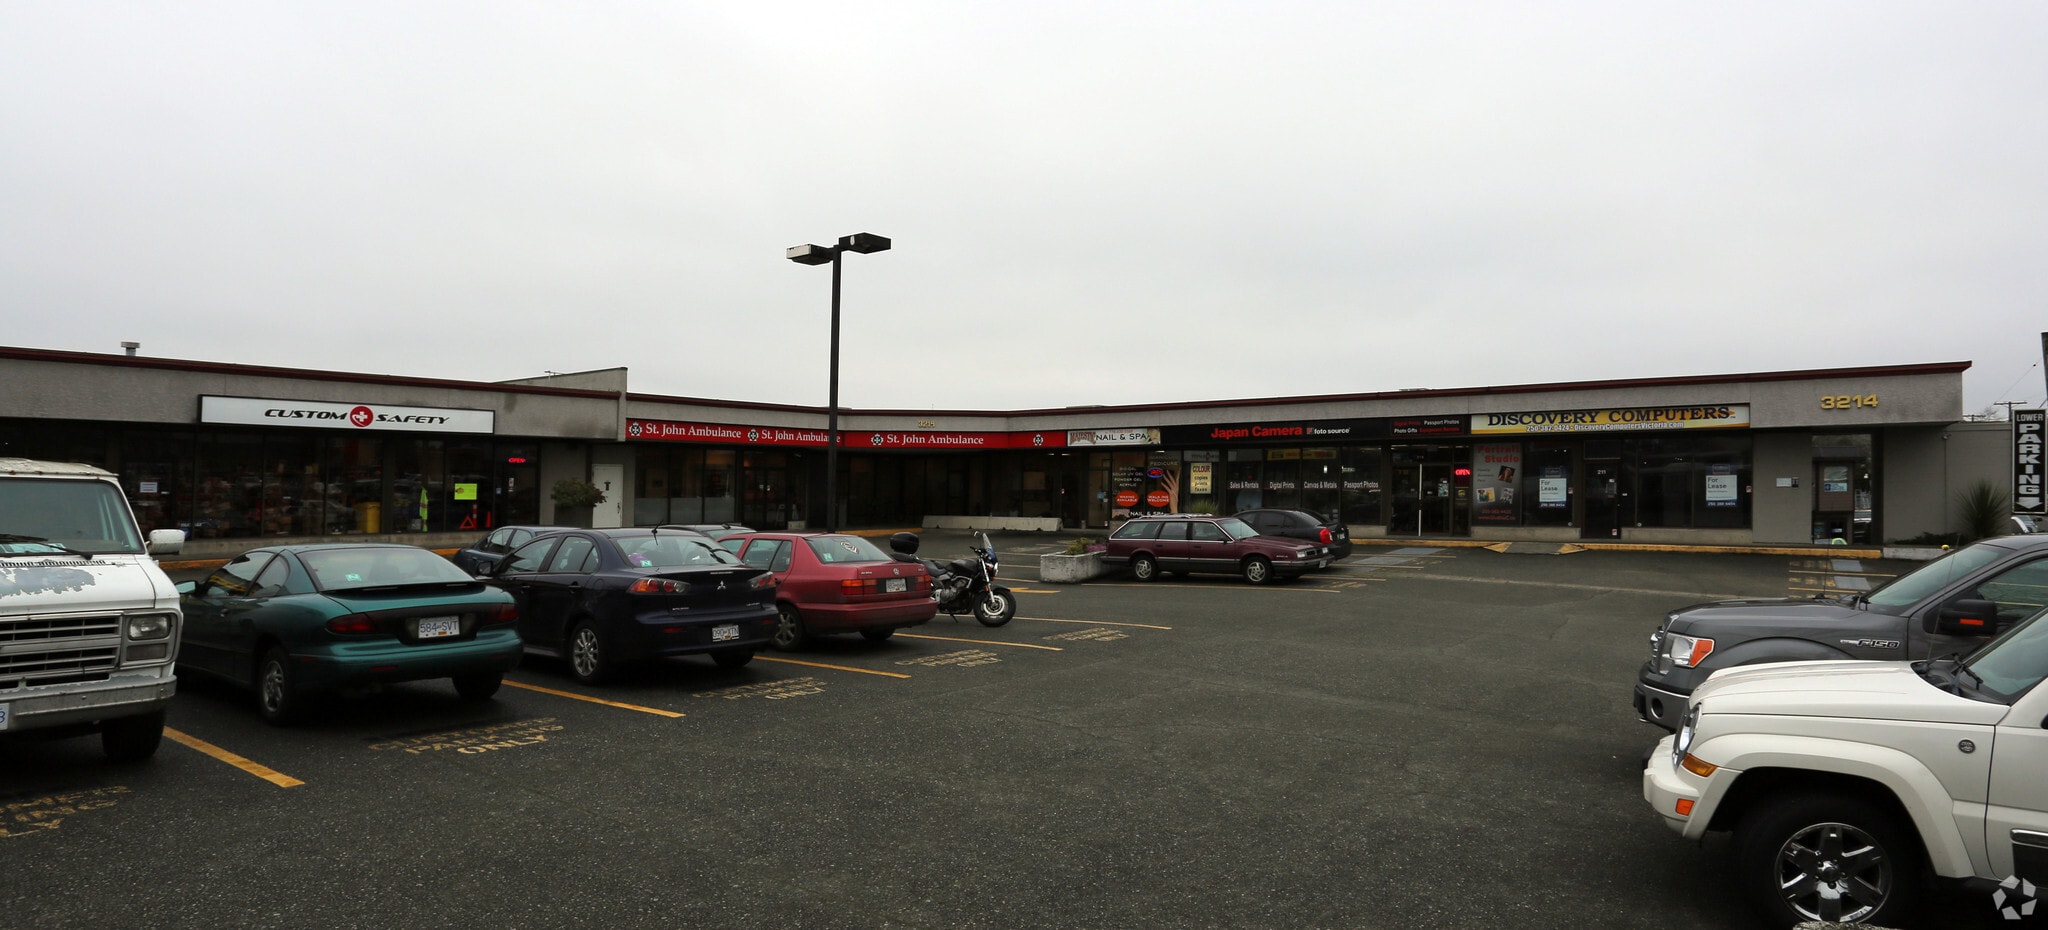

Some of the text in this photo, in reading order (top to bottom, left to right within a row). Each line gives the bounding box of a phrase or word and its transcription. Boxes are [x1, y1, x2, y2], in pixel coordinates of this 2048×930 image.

[1820, 394, 1878, 410] 3214
[264, 409, 451, 424] CUSTOM SAFETY
[1487, 407, 1730, 426] DISCOVERY COMPUTERS
[2016, 413, 2044, 422] LOWER
[645, 423, 742, 439] St. John Ambulance
[1210, 425, 1303, 440] Japan Camera
[761, 430, 840, 443] St. John Ambulae
[886, 434, 984, 445] St. John Ambulance
[1096, 433, 1117, 441] NAIL
[1119, 433, 1126, 441] &
[1129, 432, 1148, 440] SPA
[1478, 444, 1520, 453] Portrait
[1484, 454, 1520, 463] Studio
[2017, 423, 2042, 494] PARKING
[1193, 465, 1210, 473] COLOUR
[1230, 481, 1240, 489] Sales
[1269, 481, 1282, 490] Digital
[1304, 481, 1319, 489] Canvas
[1344, 481, 1379, 490] Passport Photos
[457, 734, 547, 754] ONLY
